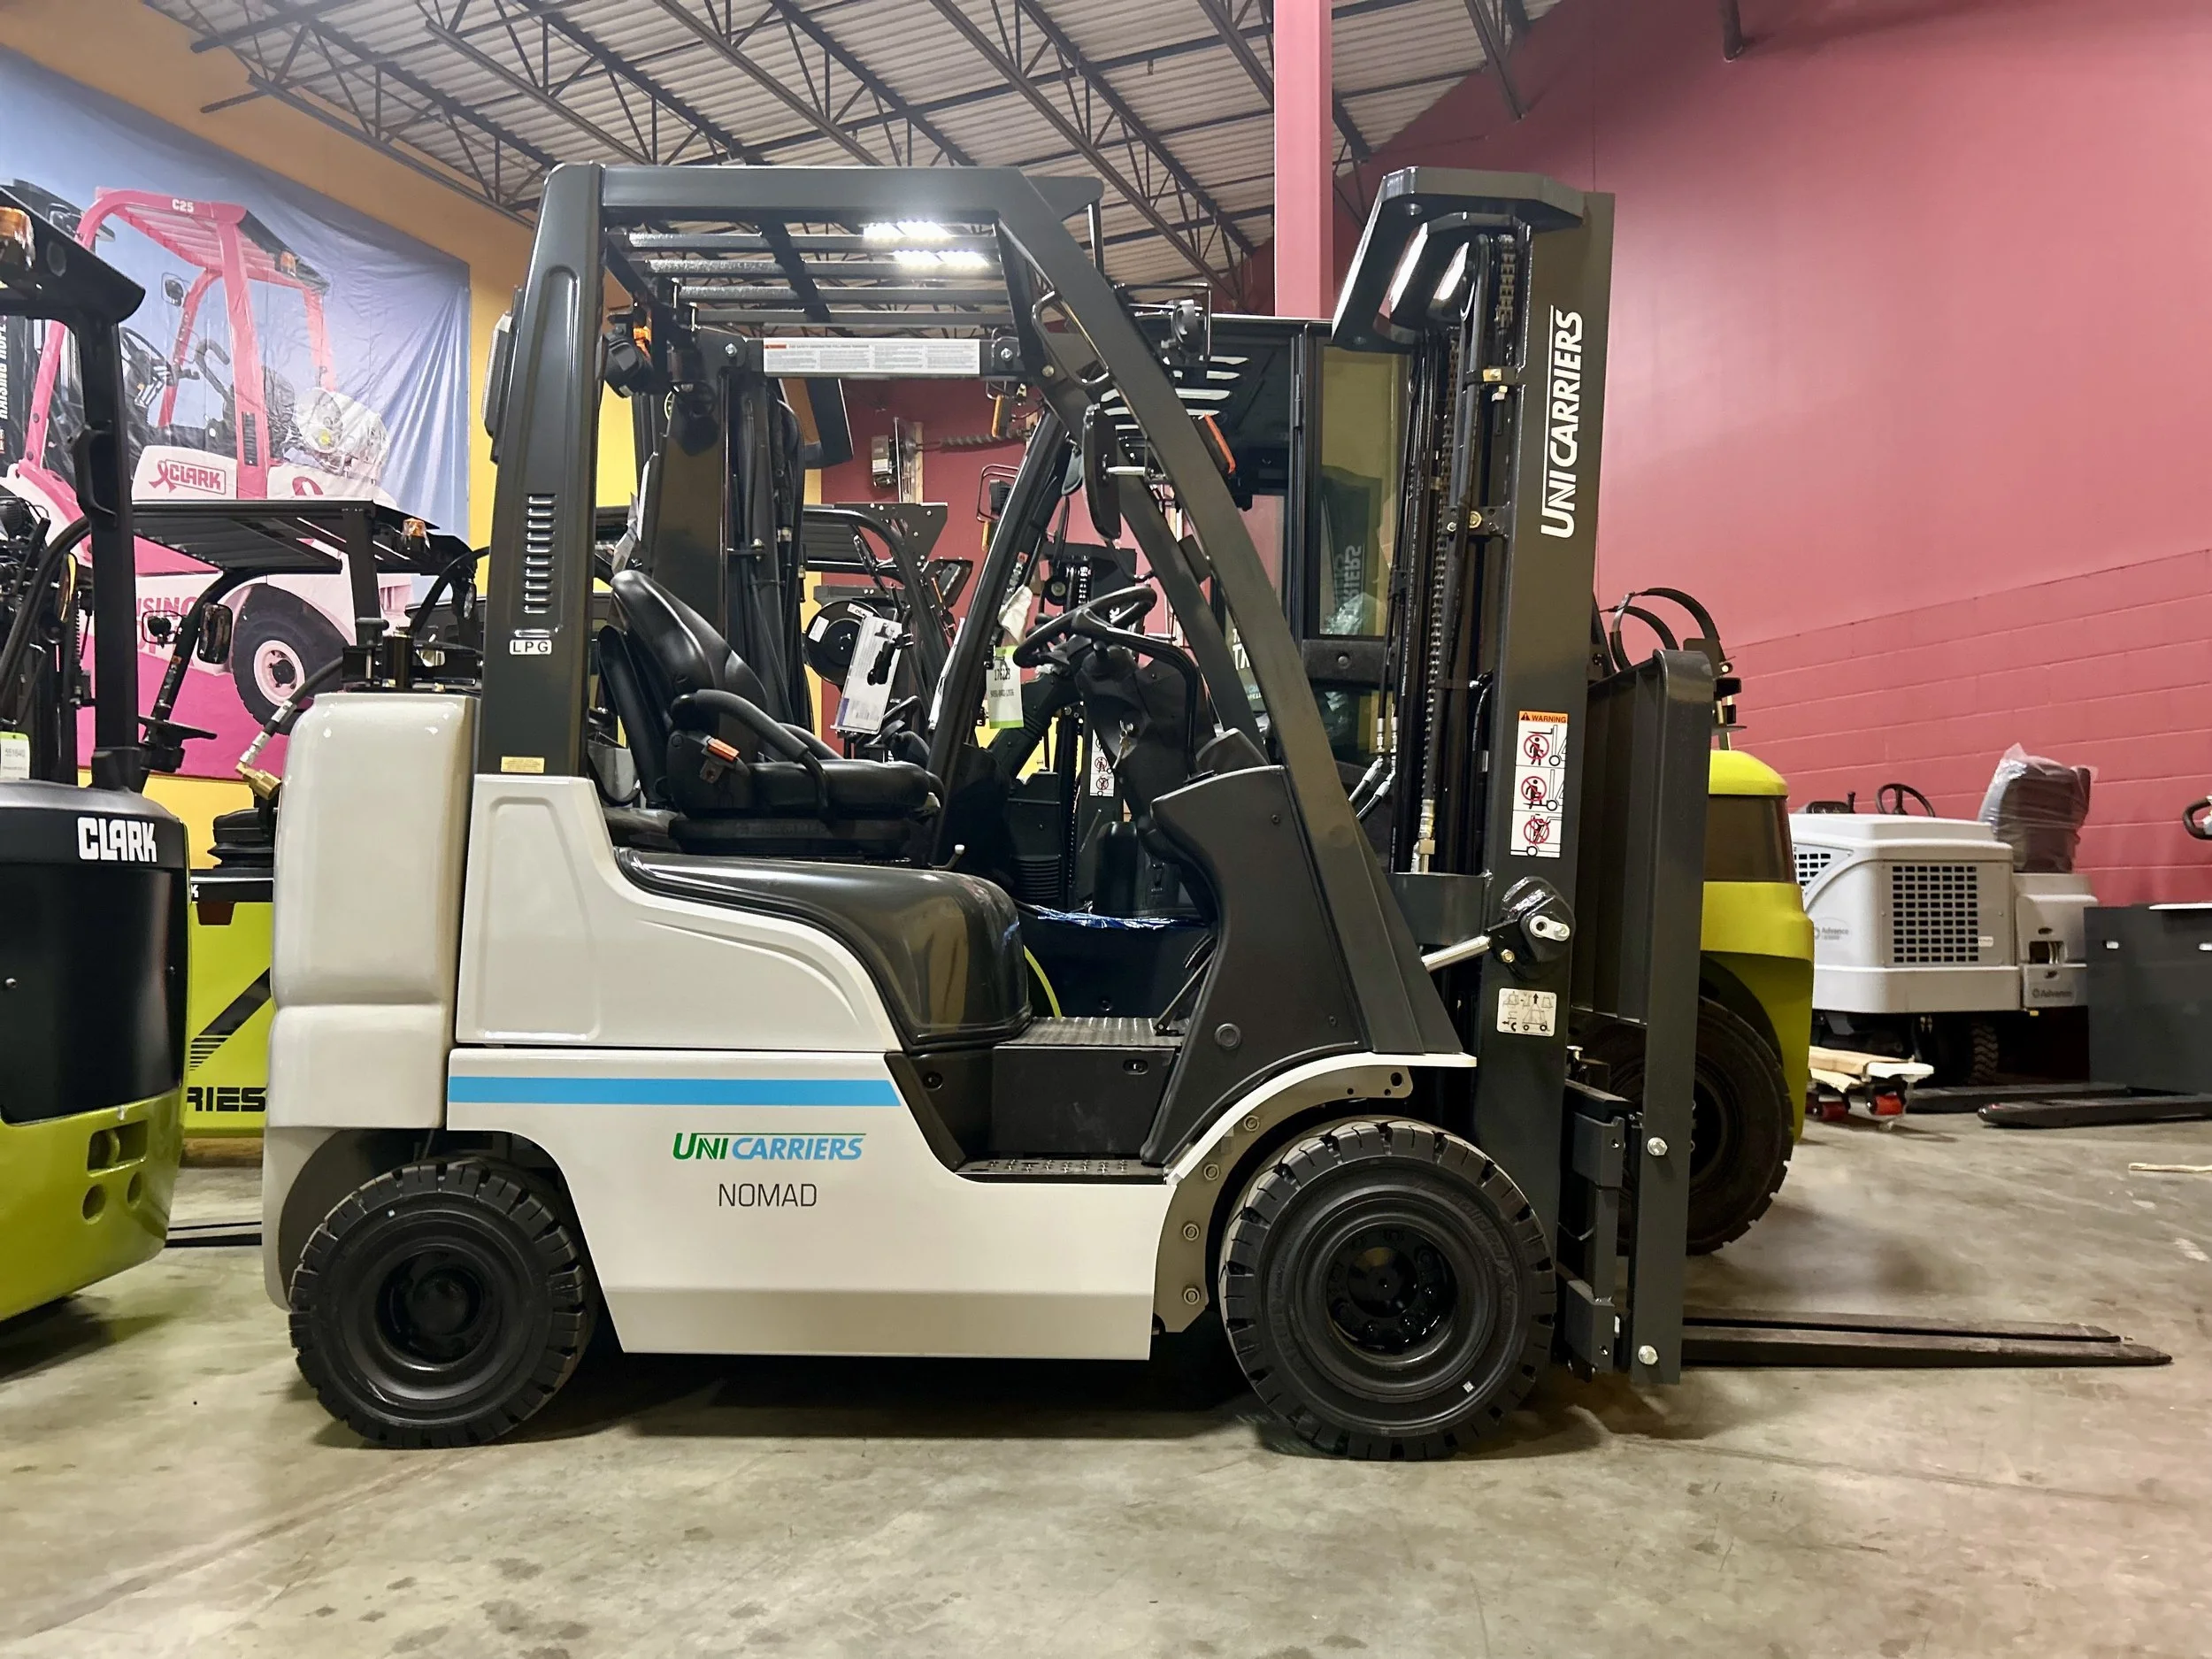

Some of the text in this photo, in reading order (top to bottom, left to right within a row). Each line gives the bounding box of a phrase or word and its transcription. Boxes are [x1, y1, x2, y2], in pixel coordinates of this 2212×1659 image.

[172, 198, 194, 212] C25
[169, 464, 221, 491] CLARK
[512, 641, 549, 653] LPG
[1531, 714, 1567, 724] WARNING
[77, 817, 157, 863] CLARK
[718, 1183, 818, 1208] NOMAD
